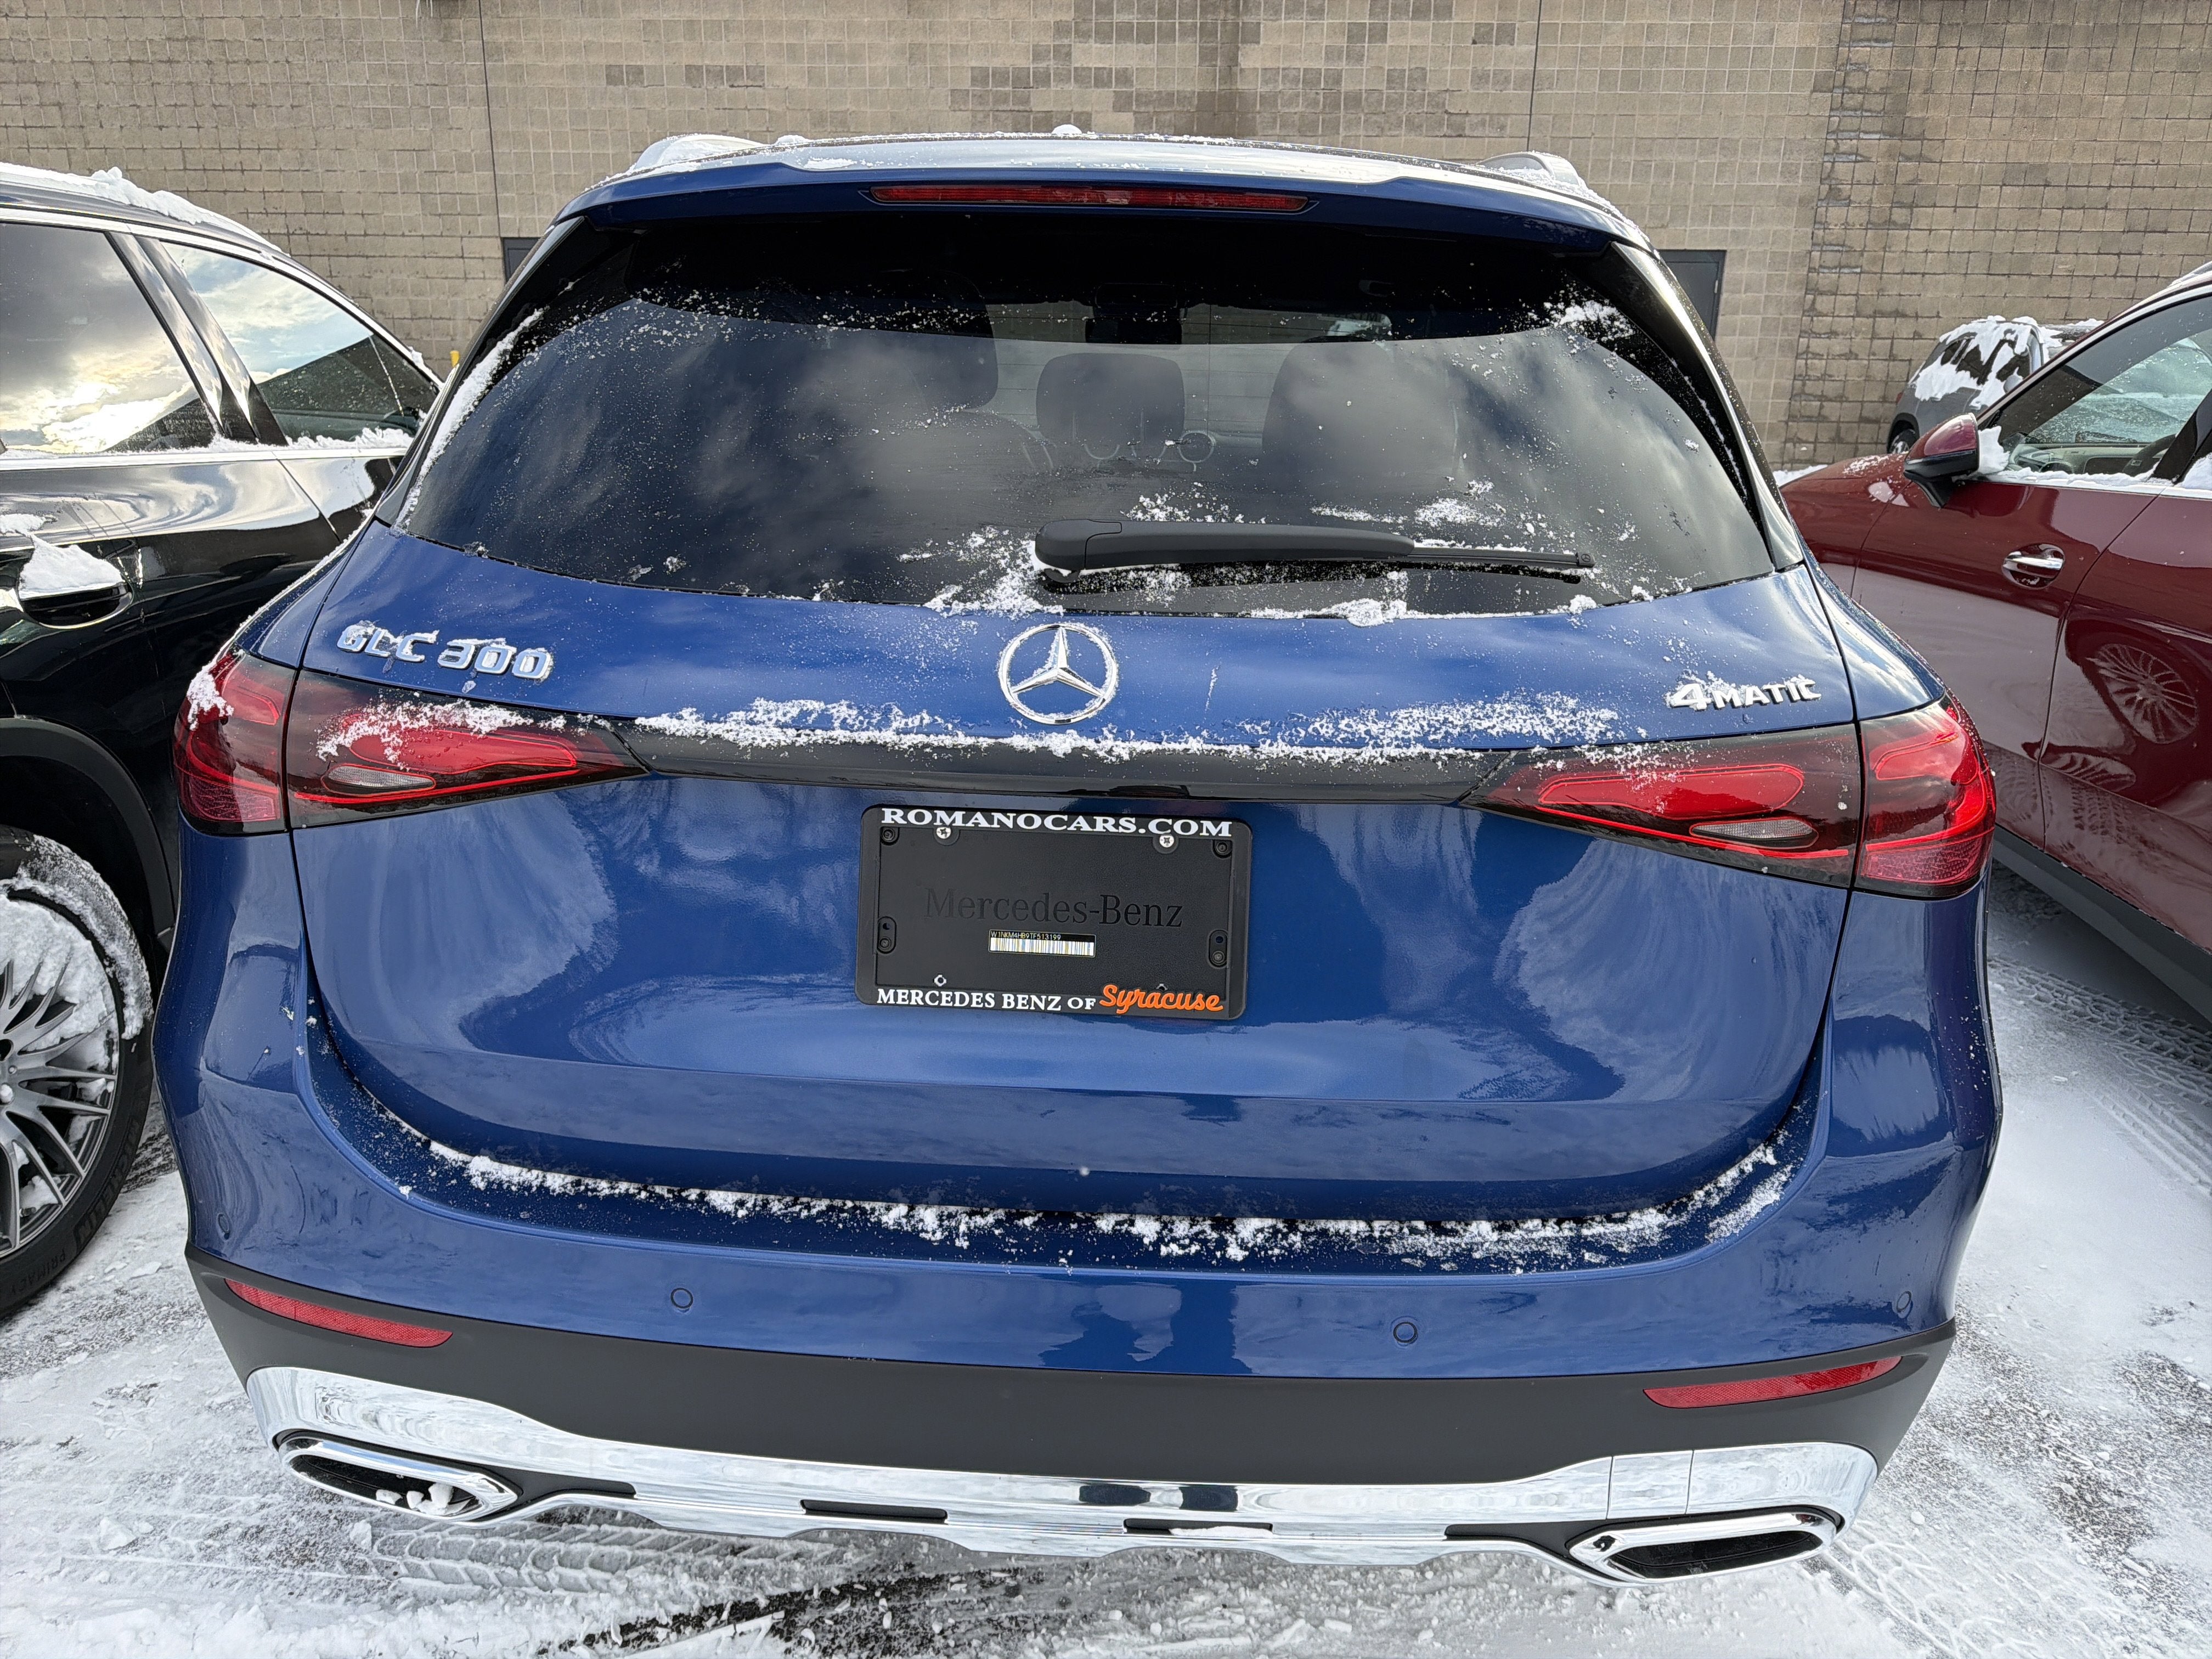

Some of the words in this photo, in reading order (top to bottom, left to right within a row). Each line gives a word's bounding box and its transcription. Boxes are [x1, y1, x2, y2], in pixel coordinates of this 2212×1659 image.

[336, 622, 437, 663] GLC
[437, 640, 551, 680] 300
[1669, 679, 1822, 711] 4MATIC
[881, 808, 1233, 837] ROMANOCARS.COM
[924, 887, 1183, 928] Mercedes-Benz
[990, 930, 1062, 941] W1NKM4HB9TF513199
[877, 988, 996, 1008] MERCEDES
[1001, 993, 1062, 1012] BENZ
[1067, 996, 1096, 1011] OF
[1099, 984, 1224, 1015] Syracuse
